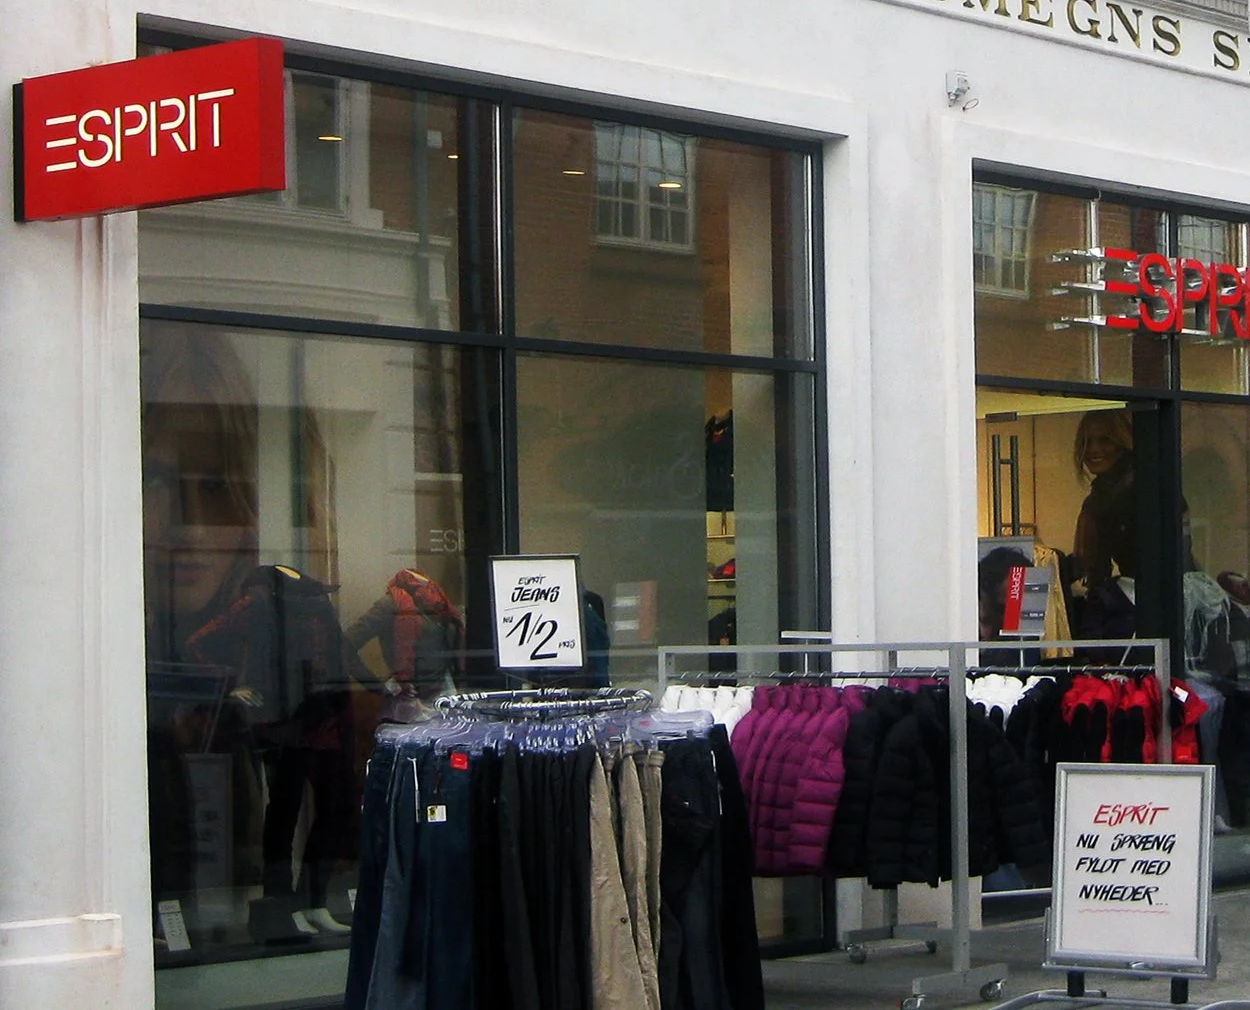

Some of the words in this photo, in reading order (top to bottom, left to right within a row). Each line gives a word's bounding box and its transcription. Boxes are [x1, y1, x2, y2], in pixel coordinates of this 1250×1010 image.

[45, 88, 235, 173] ESPRIT
[511, 586, 560, 602] JEANS
[505, 611, 558, 661] 1/2
[1076, 834, 1099, 849] NU
[1111, 833, 1176, 854] SPRÆNG
[1075, 856, 1127, 875] FYLDT
[1131, 859, 1171, 876] MED
